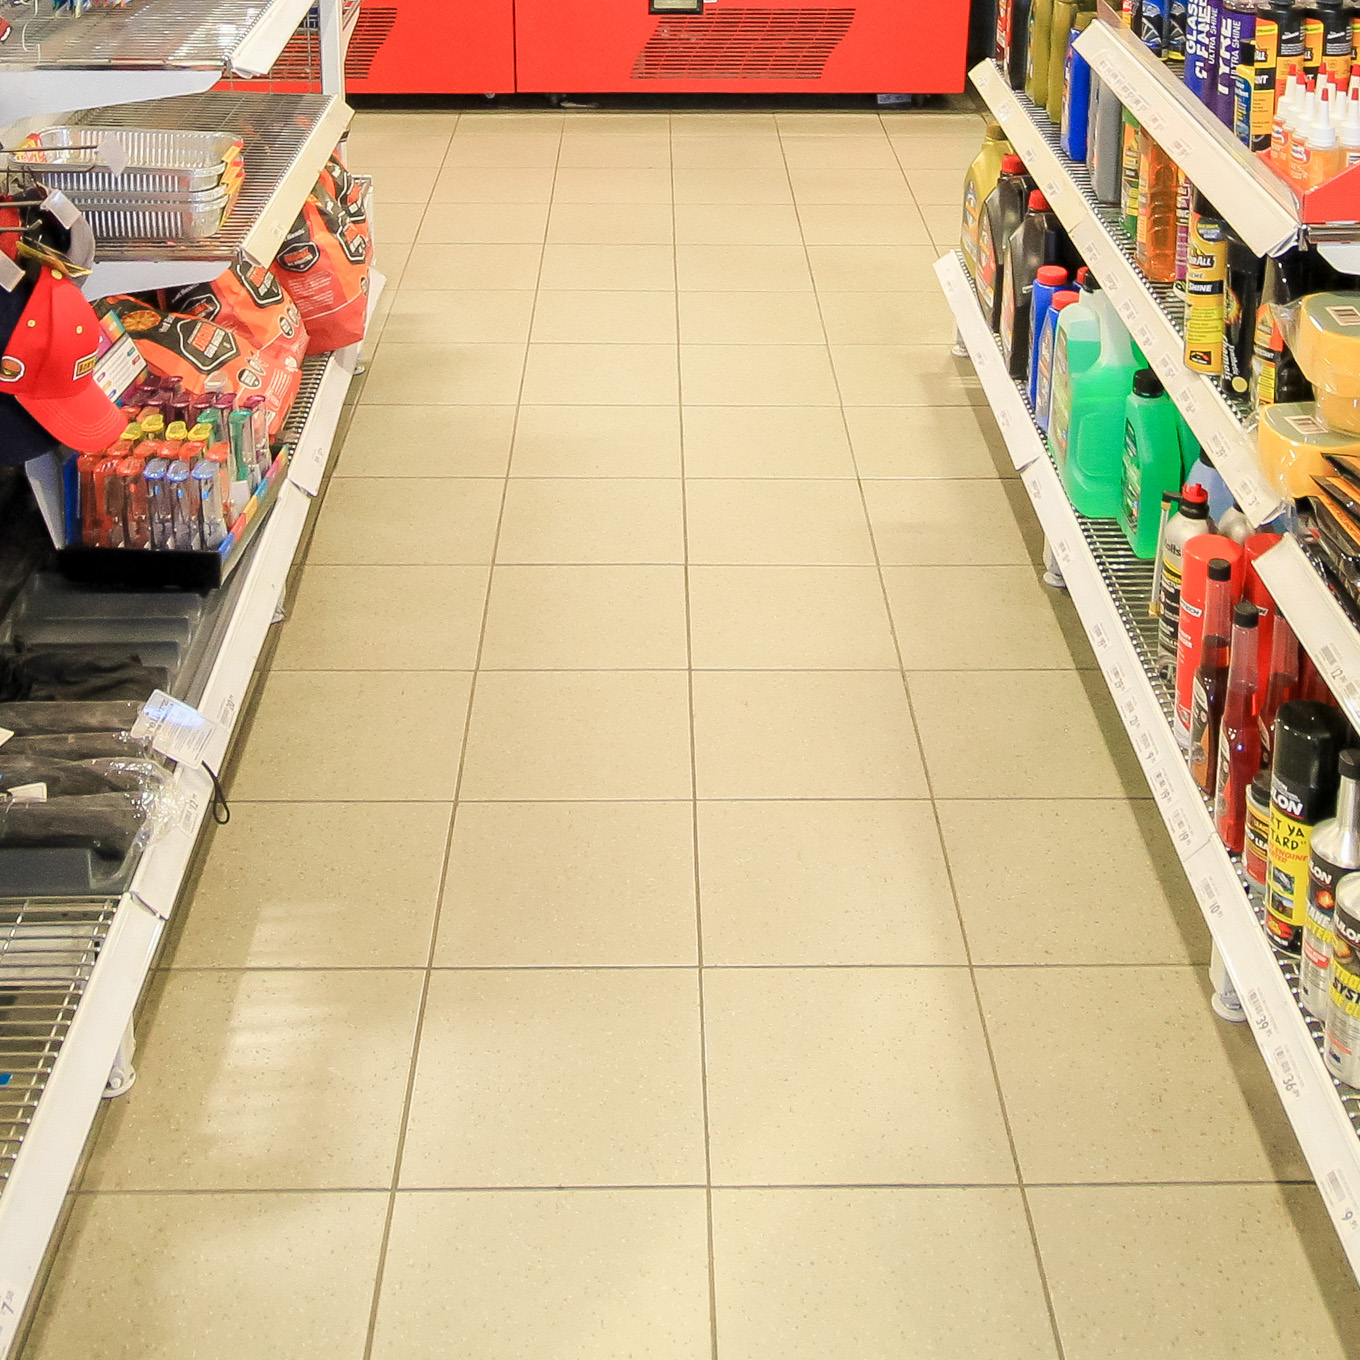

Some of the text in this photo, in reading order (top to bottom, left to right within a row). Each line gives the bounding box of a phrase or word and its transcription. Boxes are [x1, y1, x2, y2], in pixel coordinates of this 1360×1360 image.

[1208, 6, 1219, 65] ULTRA SHINE
[1231, 19, 1242, 46] SHINE
[1217, 17, 1233, 96] TYRE
[1288, 824, 1304, 838] YA
